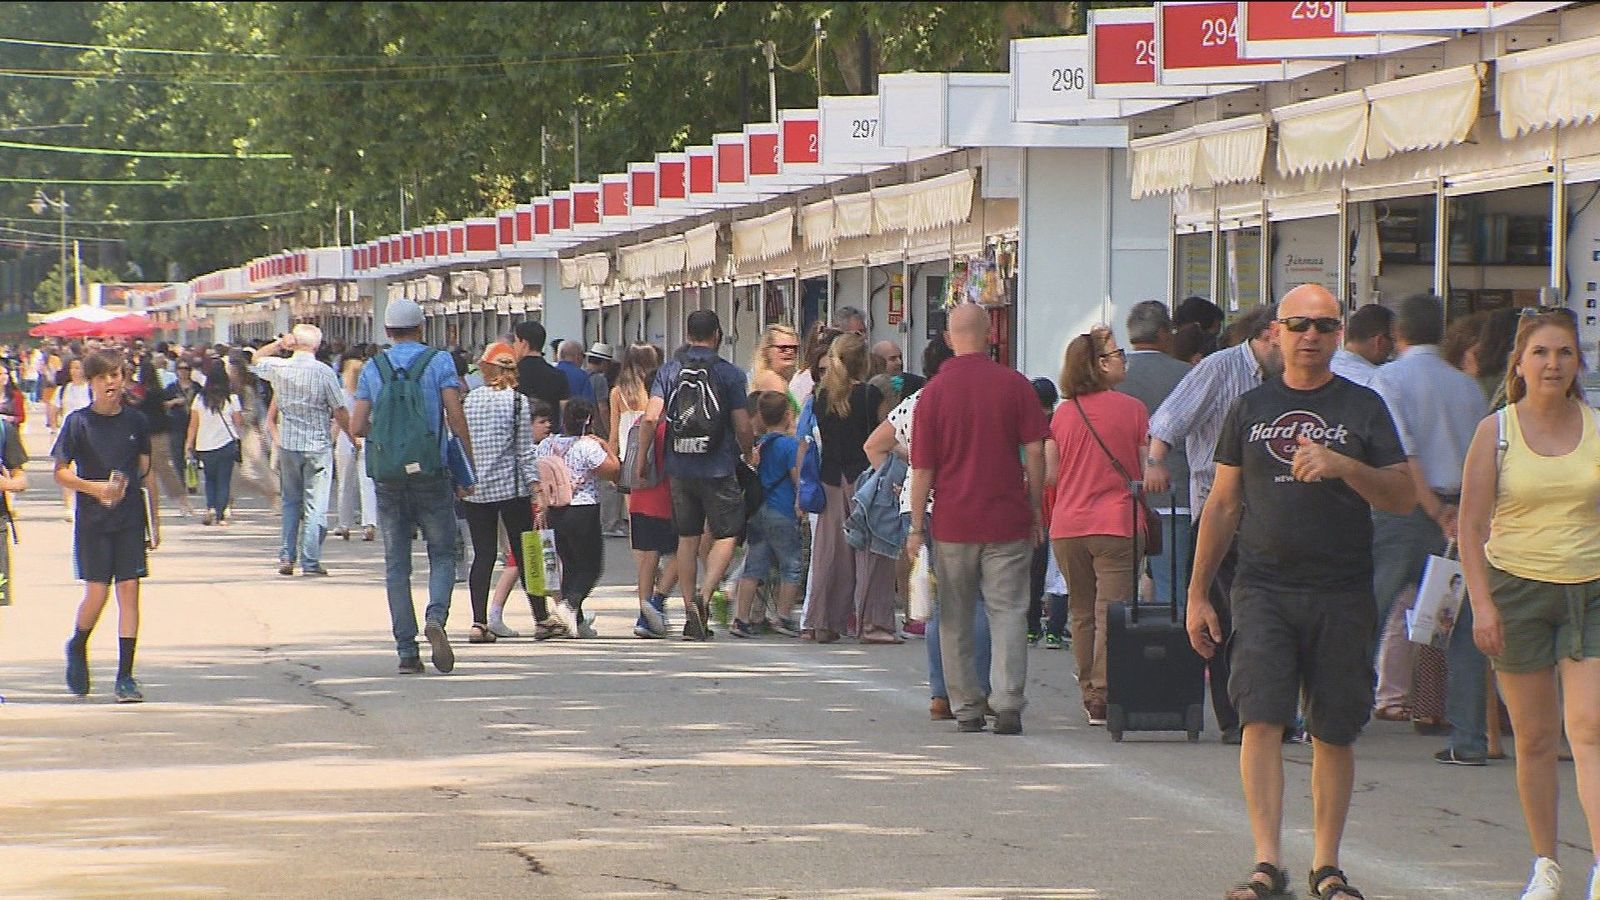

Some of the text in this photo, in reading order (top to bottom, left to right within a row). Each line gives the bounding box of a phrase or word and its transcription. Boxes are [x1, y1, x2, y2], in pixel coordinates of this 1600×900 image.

[1202, 17, 1239, 46] 294
[1135, 40, 1155, 65] 29
[1052, 67, 1084, 91] 296
[852, 119, 878, 138] 297
[1248, 421, 1348, 444] Hard Rock
[673, 438, 708, 453] NIKE
